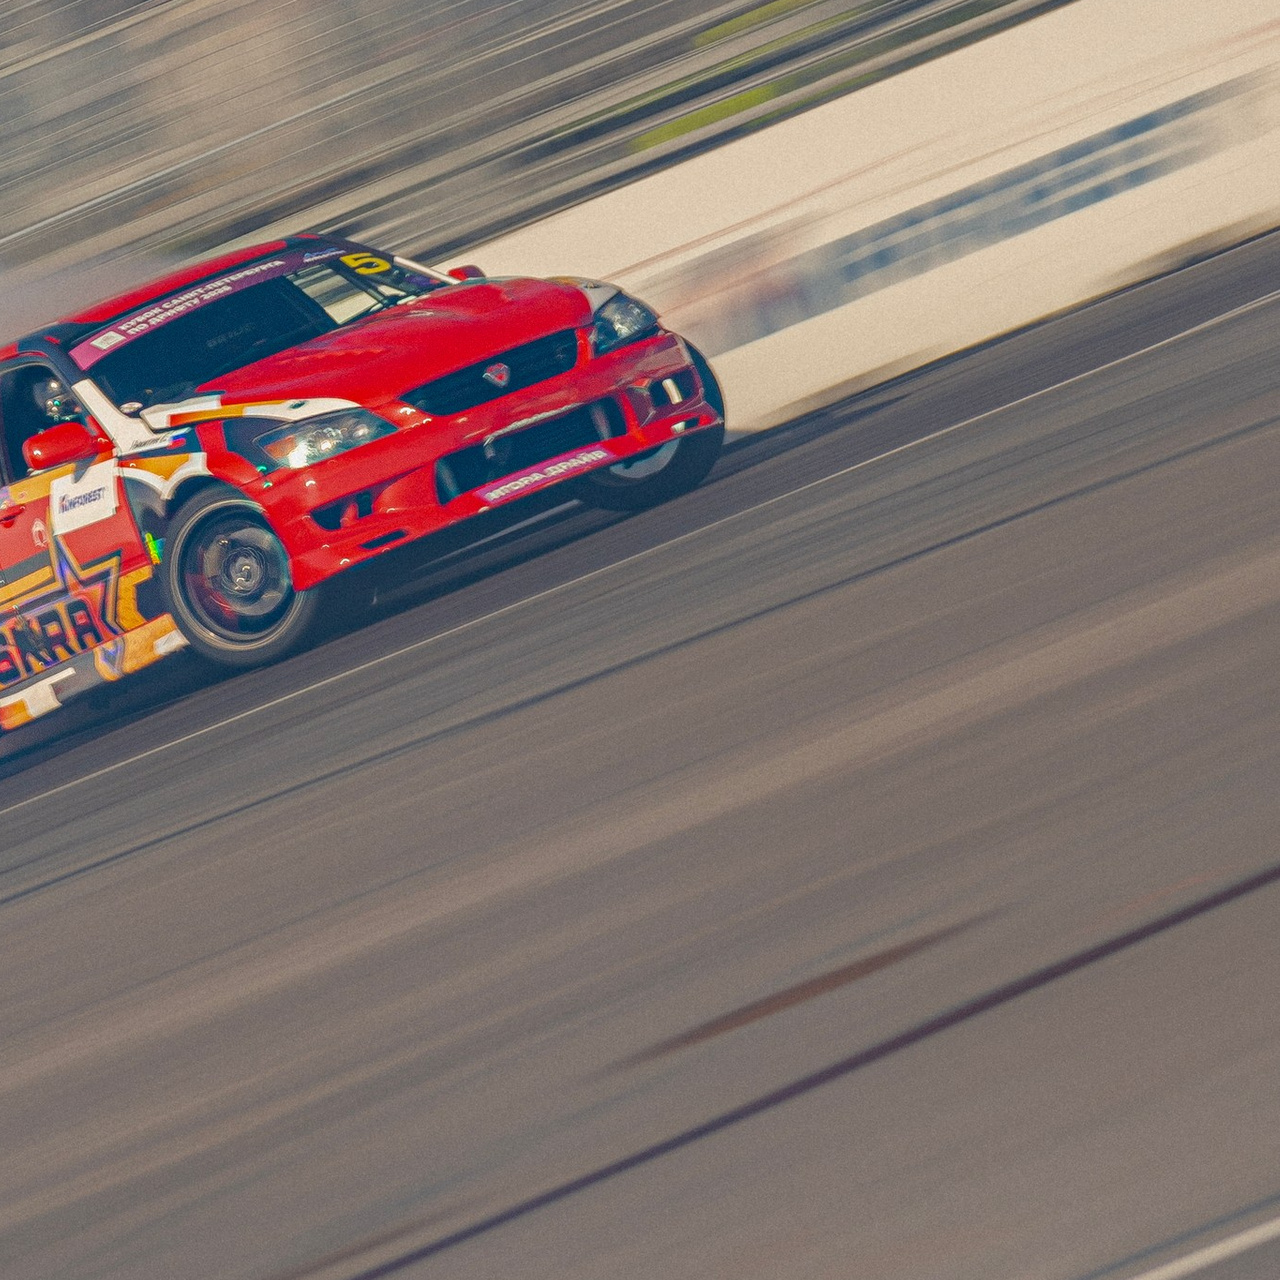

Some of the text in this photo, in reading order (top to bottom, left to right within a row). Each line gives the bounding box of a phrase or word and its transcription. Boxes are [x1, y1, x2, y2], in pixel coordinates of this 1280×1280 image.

[339, 252, 392, 275] 5
[118, 260, 286, 331] КУБОК САНКТ-ПЕТЕРБУРГА
[126, 322, 149, 336] ПО
[148, 297, 200, 325] ДРИФТУ
[543, 449, 608, 478] ДРАЙВ
